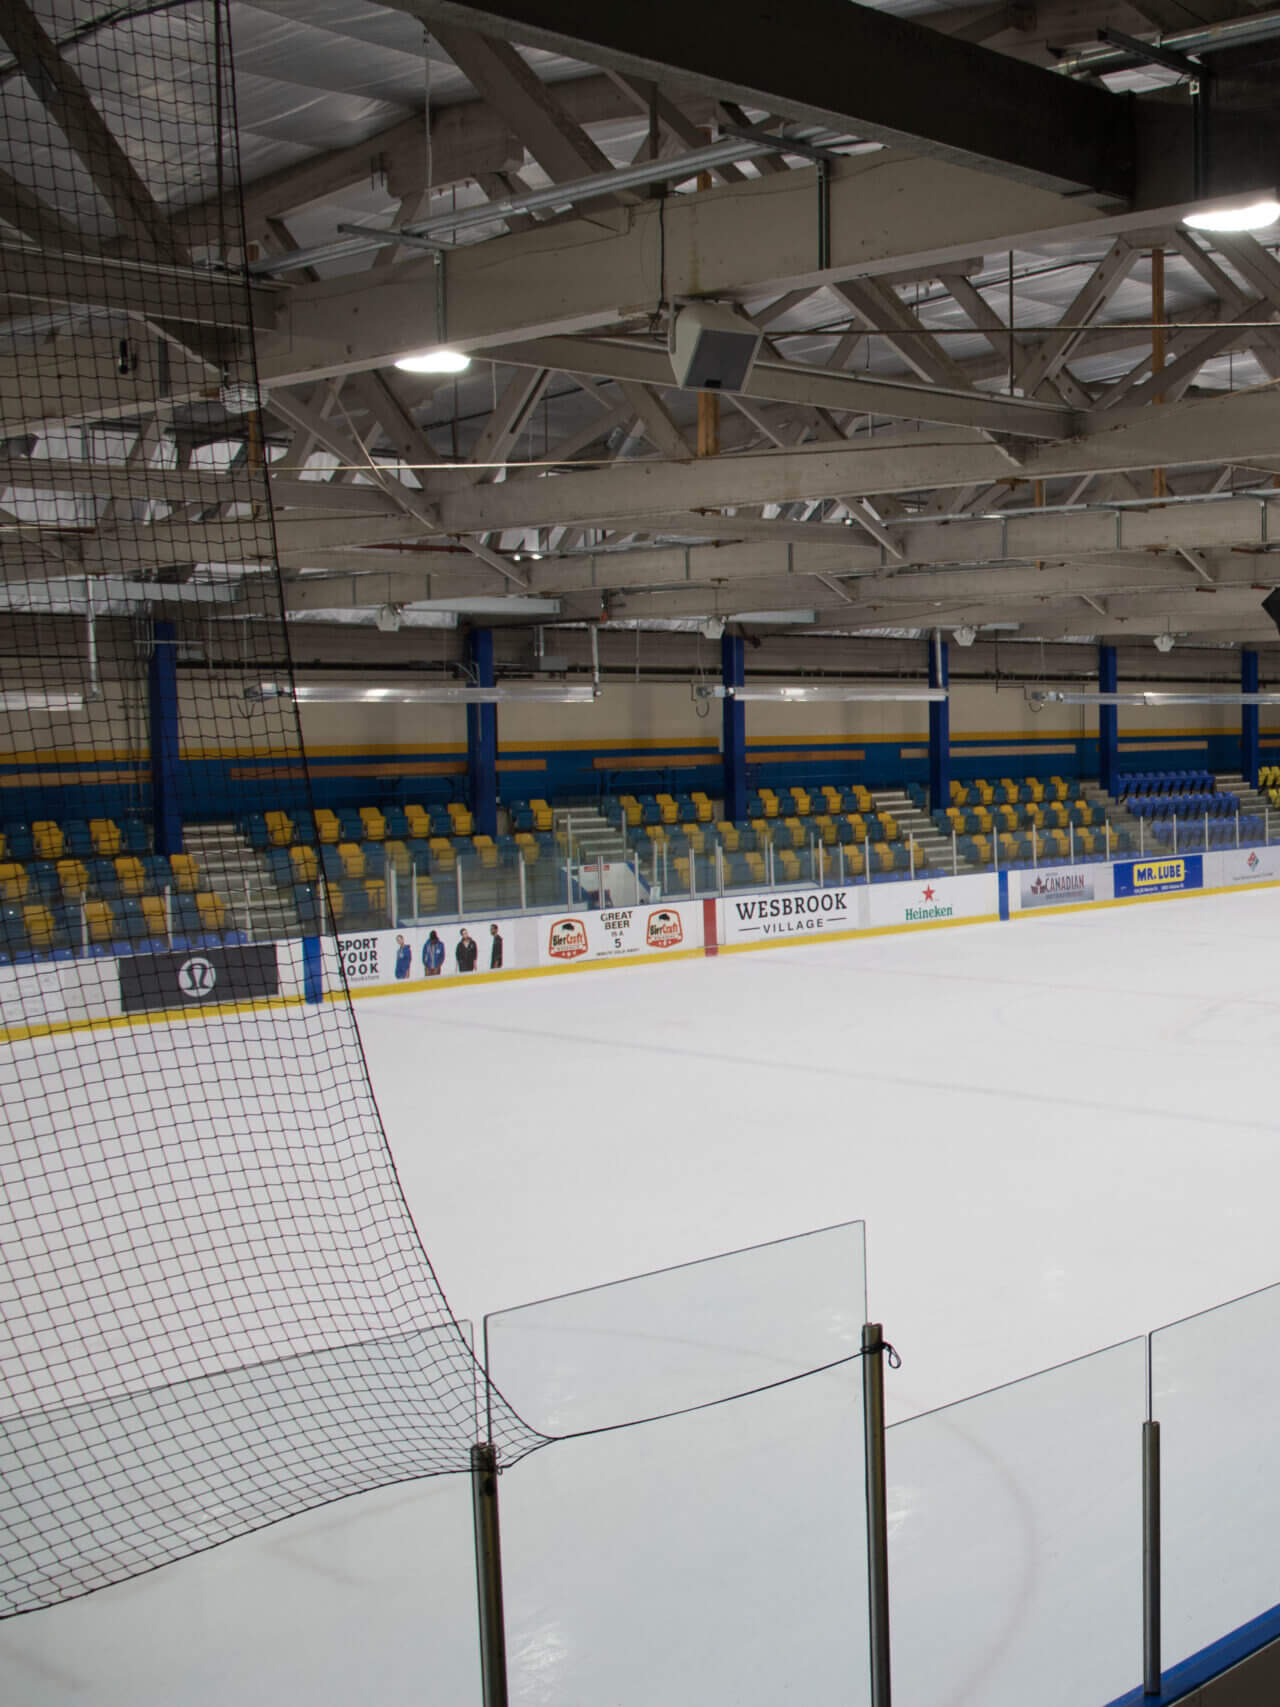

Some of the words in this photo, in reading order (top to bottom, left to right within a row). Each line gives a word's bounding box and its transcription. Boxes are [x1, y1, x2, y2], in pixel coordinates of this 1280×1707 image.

[1136, 867, 1157, 882] MR.
[1158, 864, 1182, 880] LUBE
[1045, 873, 1085, 892] CANADIAN
[735, 892, 847, 921] WESBROOK
[905, 904, 953, 921] Heineken
[600, 911, 633, 921] GREAT
[604, 920, 630, 930] BEER
[763, 917, 825, 934] VILLAGE
[338, 937, 378, 952] SPORT
[614, 938, 622, 949] 5
